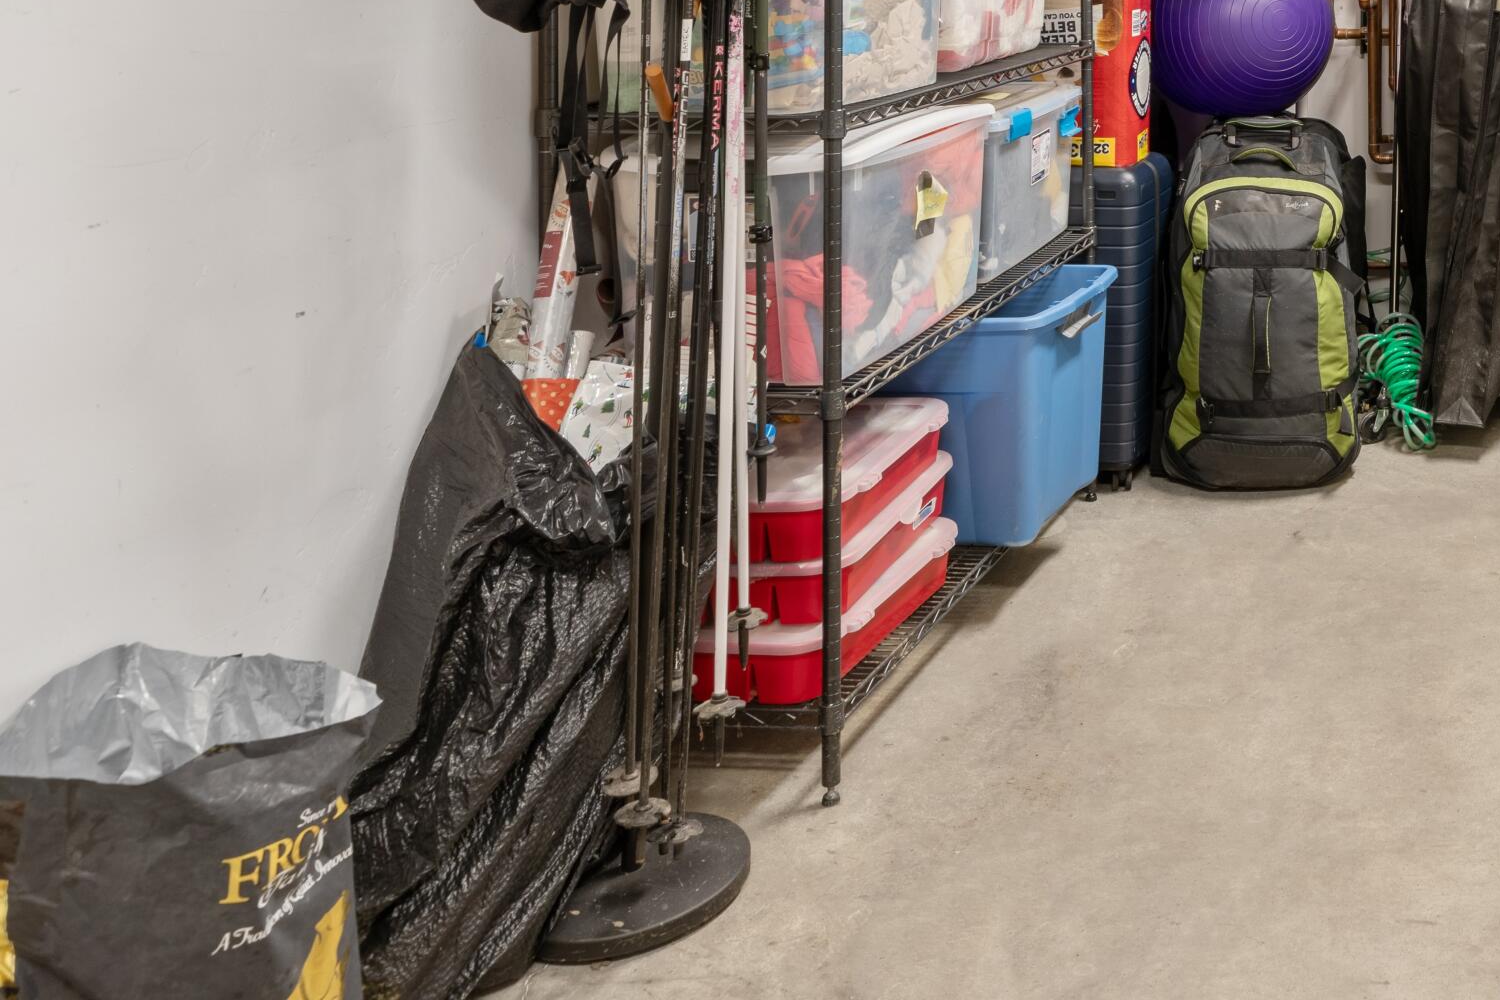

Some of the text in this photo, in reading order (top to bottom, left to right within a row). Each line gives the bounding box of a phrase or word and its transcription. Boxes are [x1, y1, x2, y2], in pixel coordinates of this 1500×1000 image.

[1059, 12, 1075, 20] YOU
[709, 60, 724, 151] KERMA
[210, 932, 231, 957] A
